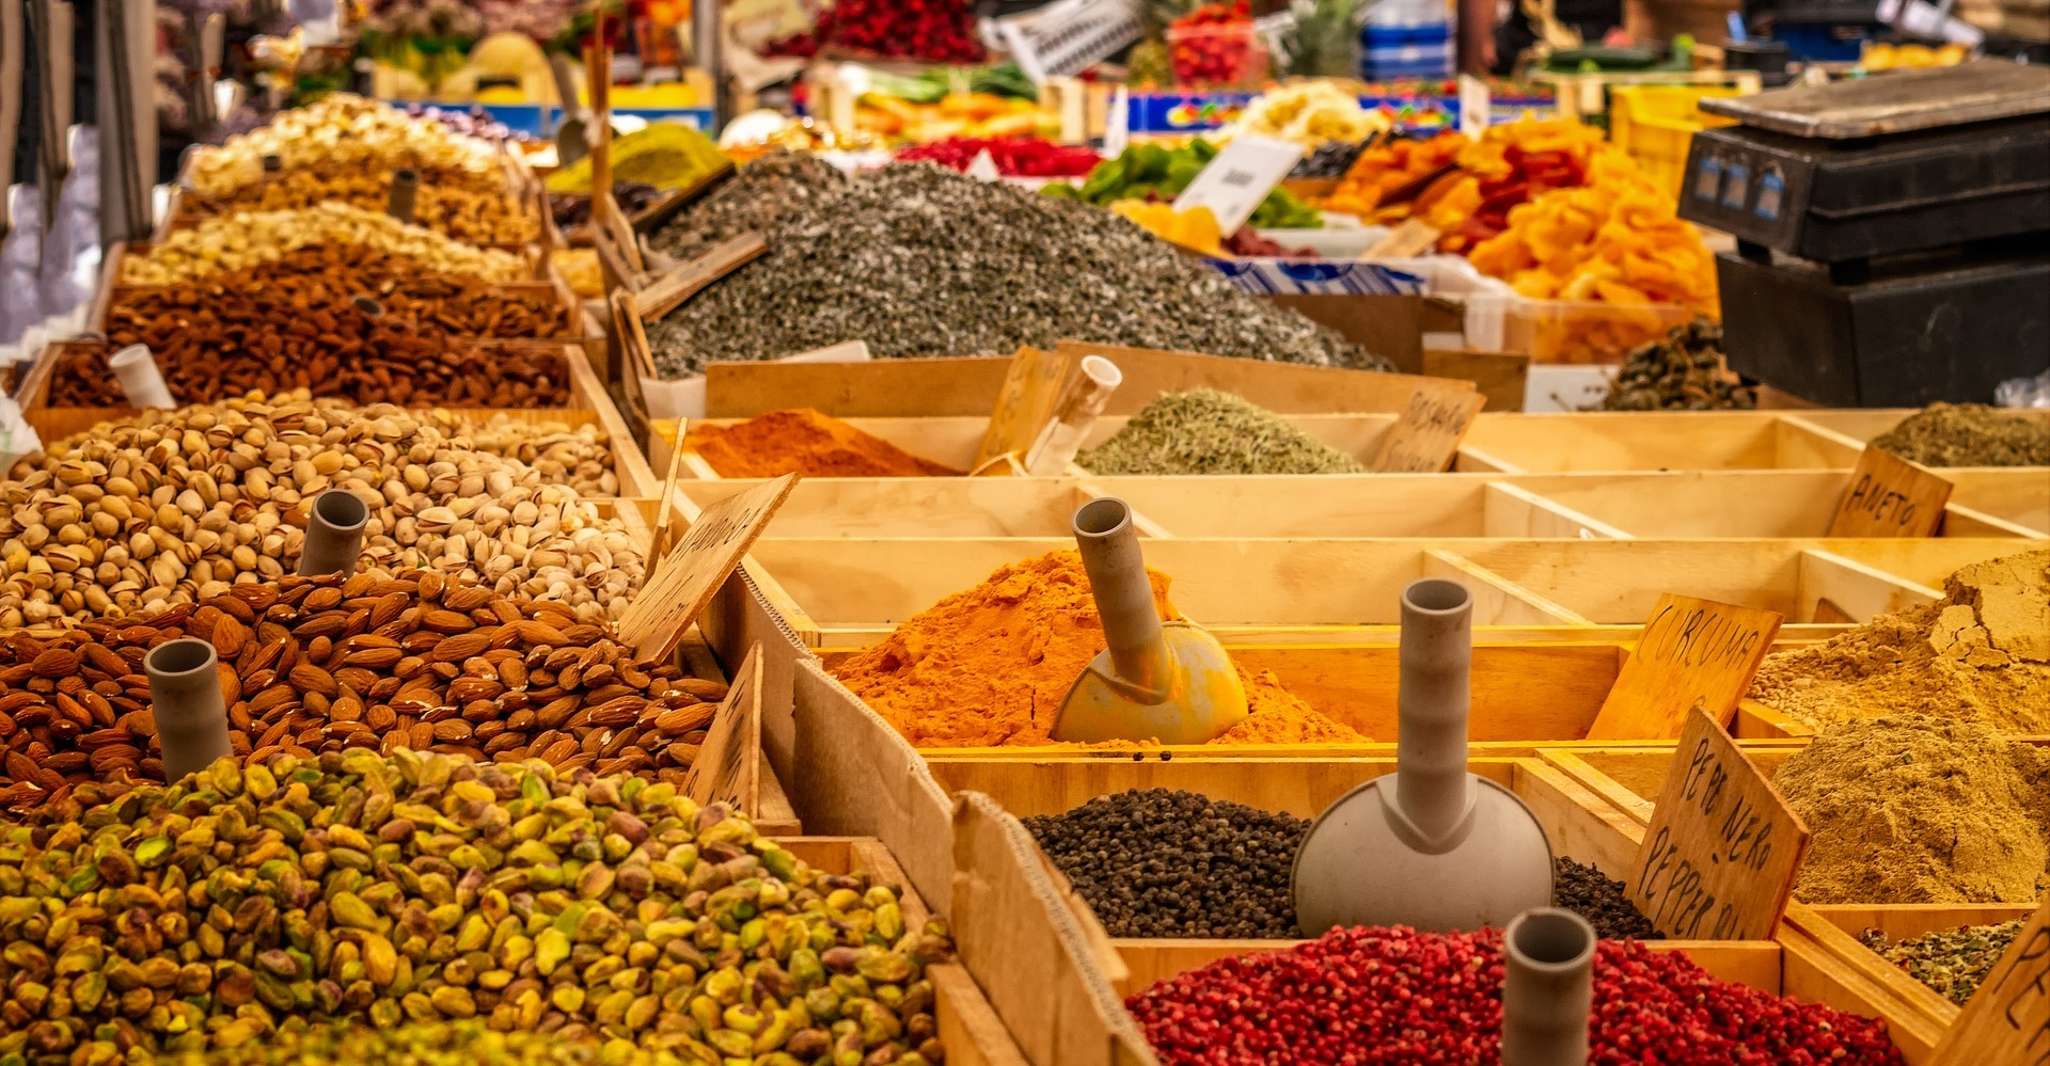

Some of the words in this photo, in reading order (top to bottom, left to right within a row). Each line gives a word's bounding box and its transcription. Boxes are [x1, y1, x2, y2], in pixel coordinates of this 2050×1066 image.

[1844, 473, 1917, 526] ANETO
[1636, 603, 1760, 671] CURCUMA
[1680, 737, 1728, 817] PEPE
[1720, 795, 1773, 872] NERO
[1636, 825, 1715, 939] PEPPER
